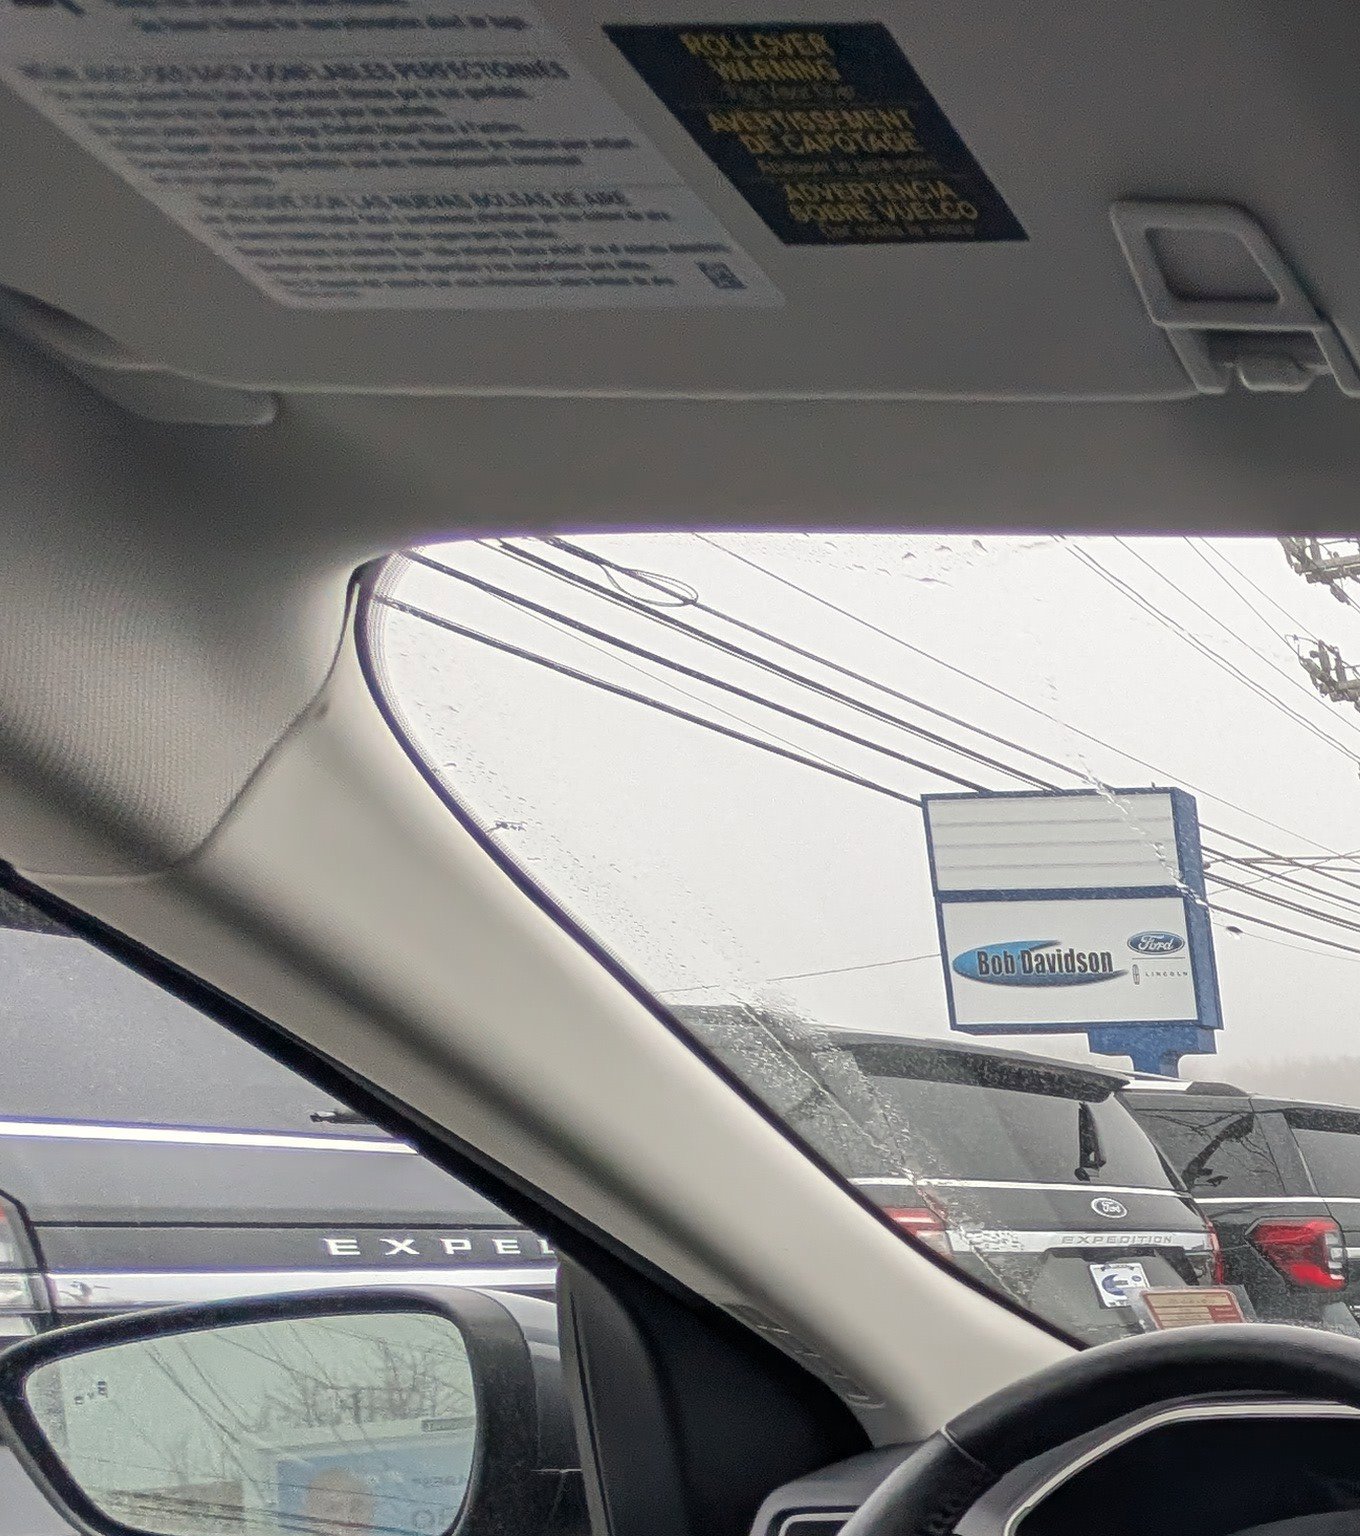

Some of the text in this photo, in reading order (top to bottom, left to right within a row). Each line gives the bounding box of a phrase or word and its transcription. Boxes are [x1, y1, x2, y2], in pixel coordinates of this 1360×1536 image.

[680, 32, 835, 56] ROLLOVER
[706, 58, 842, 81] WARNING
[1137, 934, 1174, 952] Ford
[976, 948, 1114, 975] Bob Davidson
[1061, 1235, 1173, 1245] EXPEDITION
